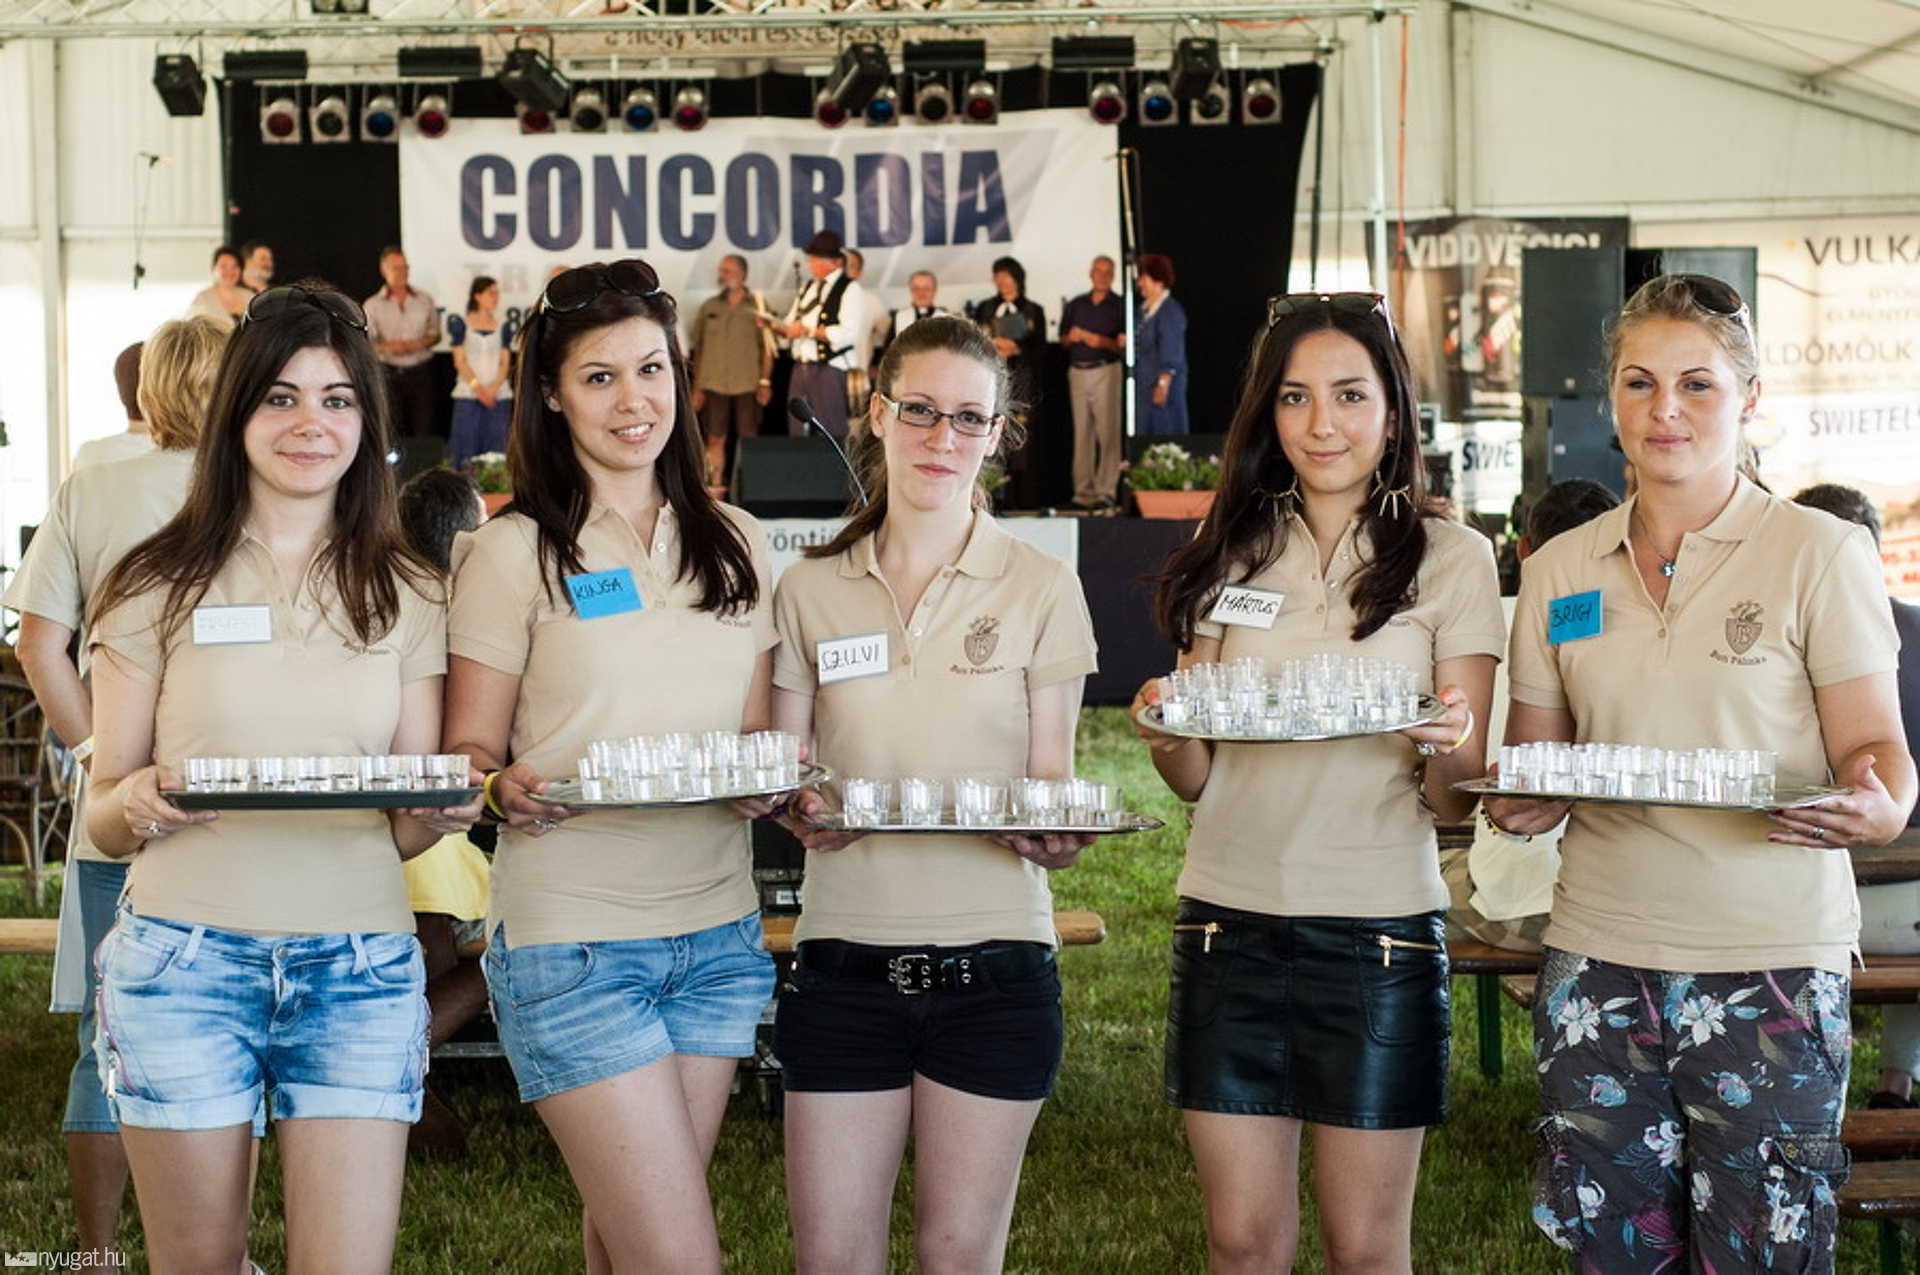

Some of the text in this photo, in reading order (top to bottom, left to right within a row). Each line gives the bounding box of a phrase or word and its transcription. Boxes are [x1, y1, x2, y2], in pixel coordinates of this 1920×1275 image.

[459, 150, 1014, 252] CONCORDIA
[1405, 235, 1482, 268] VIDD
[1765, 335, 1913, 366] LDÖMÖLK
[1462, 438, 1522, 472] SWIE
